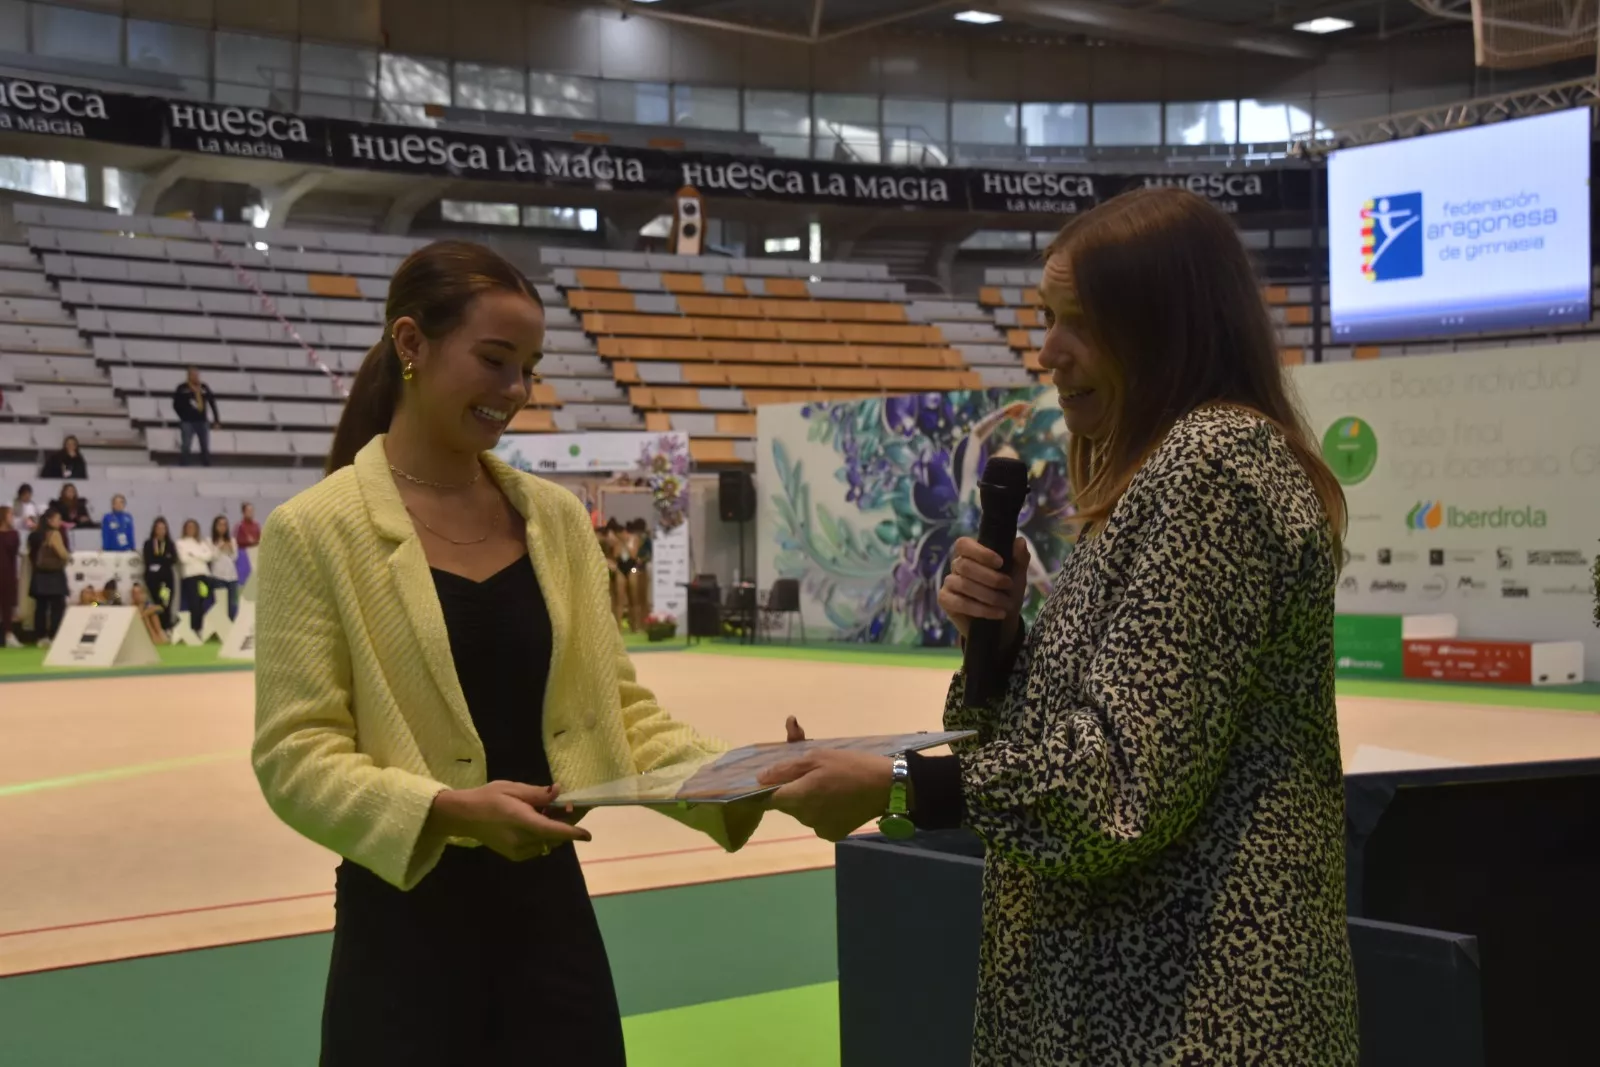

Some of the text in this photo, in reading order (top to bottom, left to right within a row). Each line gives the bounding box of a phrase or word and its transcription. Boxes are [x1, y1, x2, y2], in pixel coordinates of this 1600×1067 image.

[0, 80, 110, 119] esca
[0, 113, 13, 128] a
[170, 103, 309, 142] Huesca
[350, 133, 489, 170] Huesca
[682, 162, 805, 194] Huesca
[983, 172, 1094, 197] Huesca
[1442, 190, 1541, 218] federación
[1427, 207, 1557, 240] aragonesa
[1439, 235, 1545, 262] de gimnasia
[1447, 505, 1547, 528] Iberdrola
